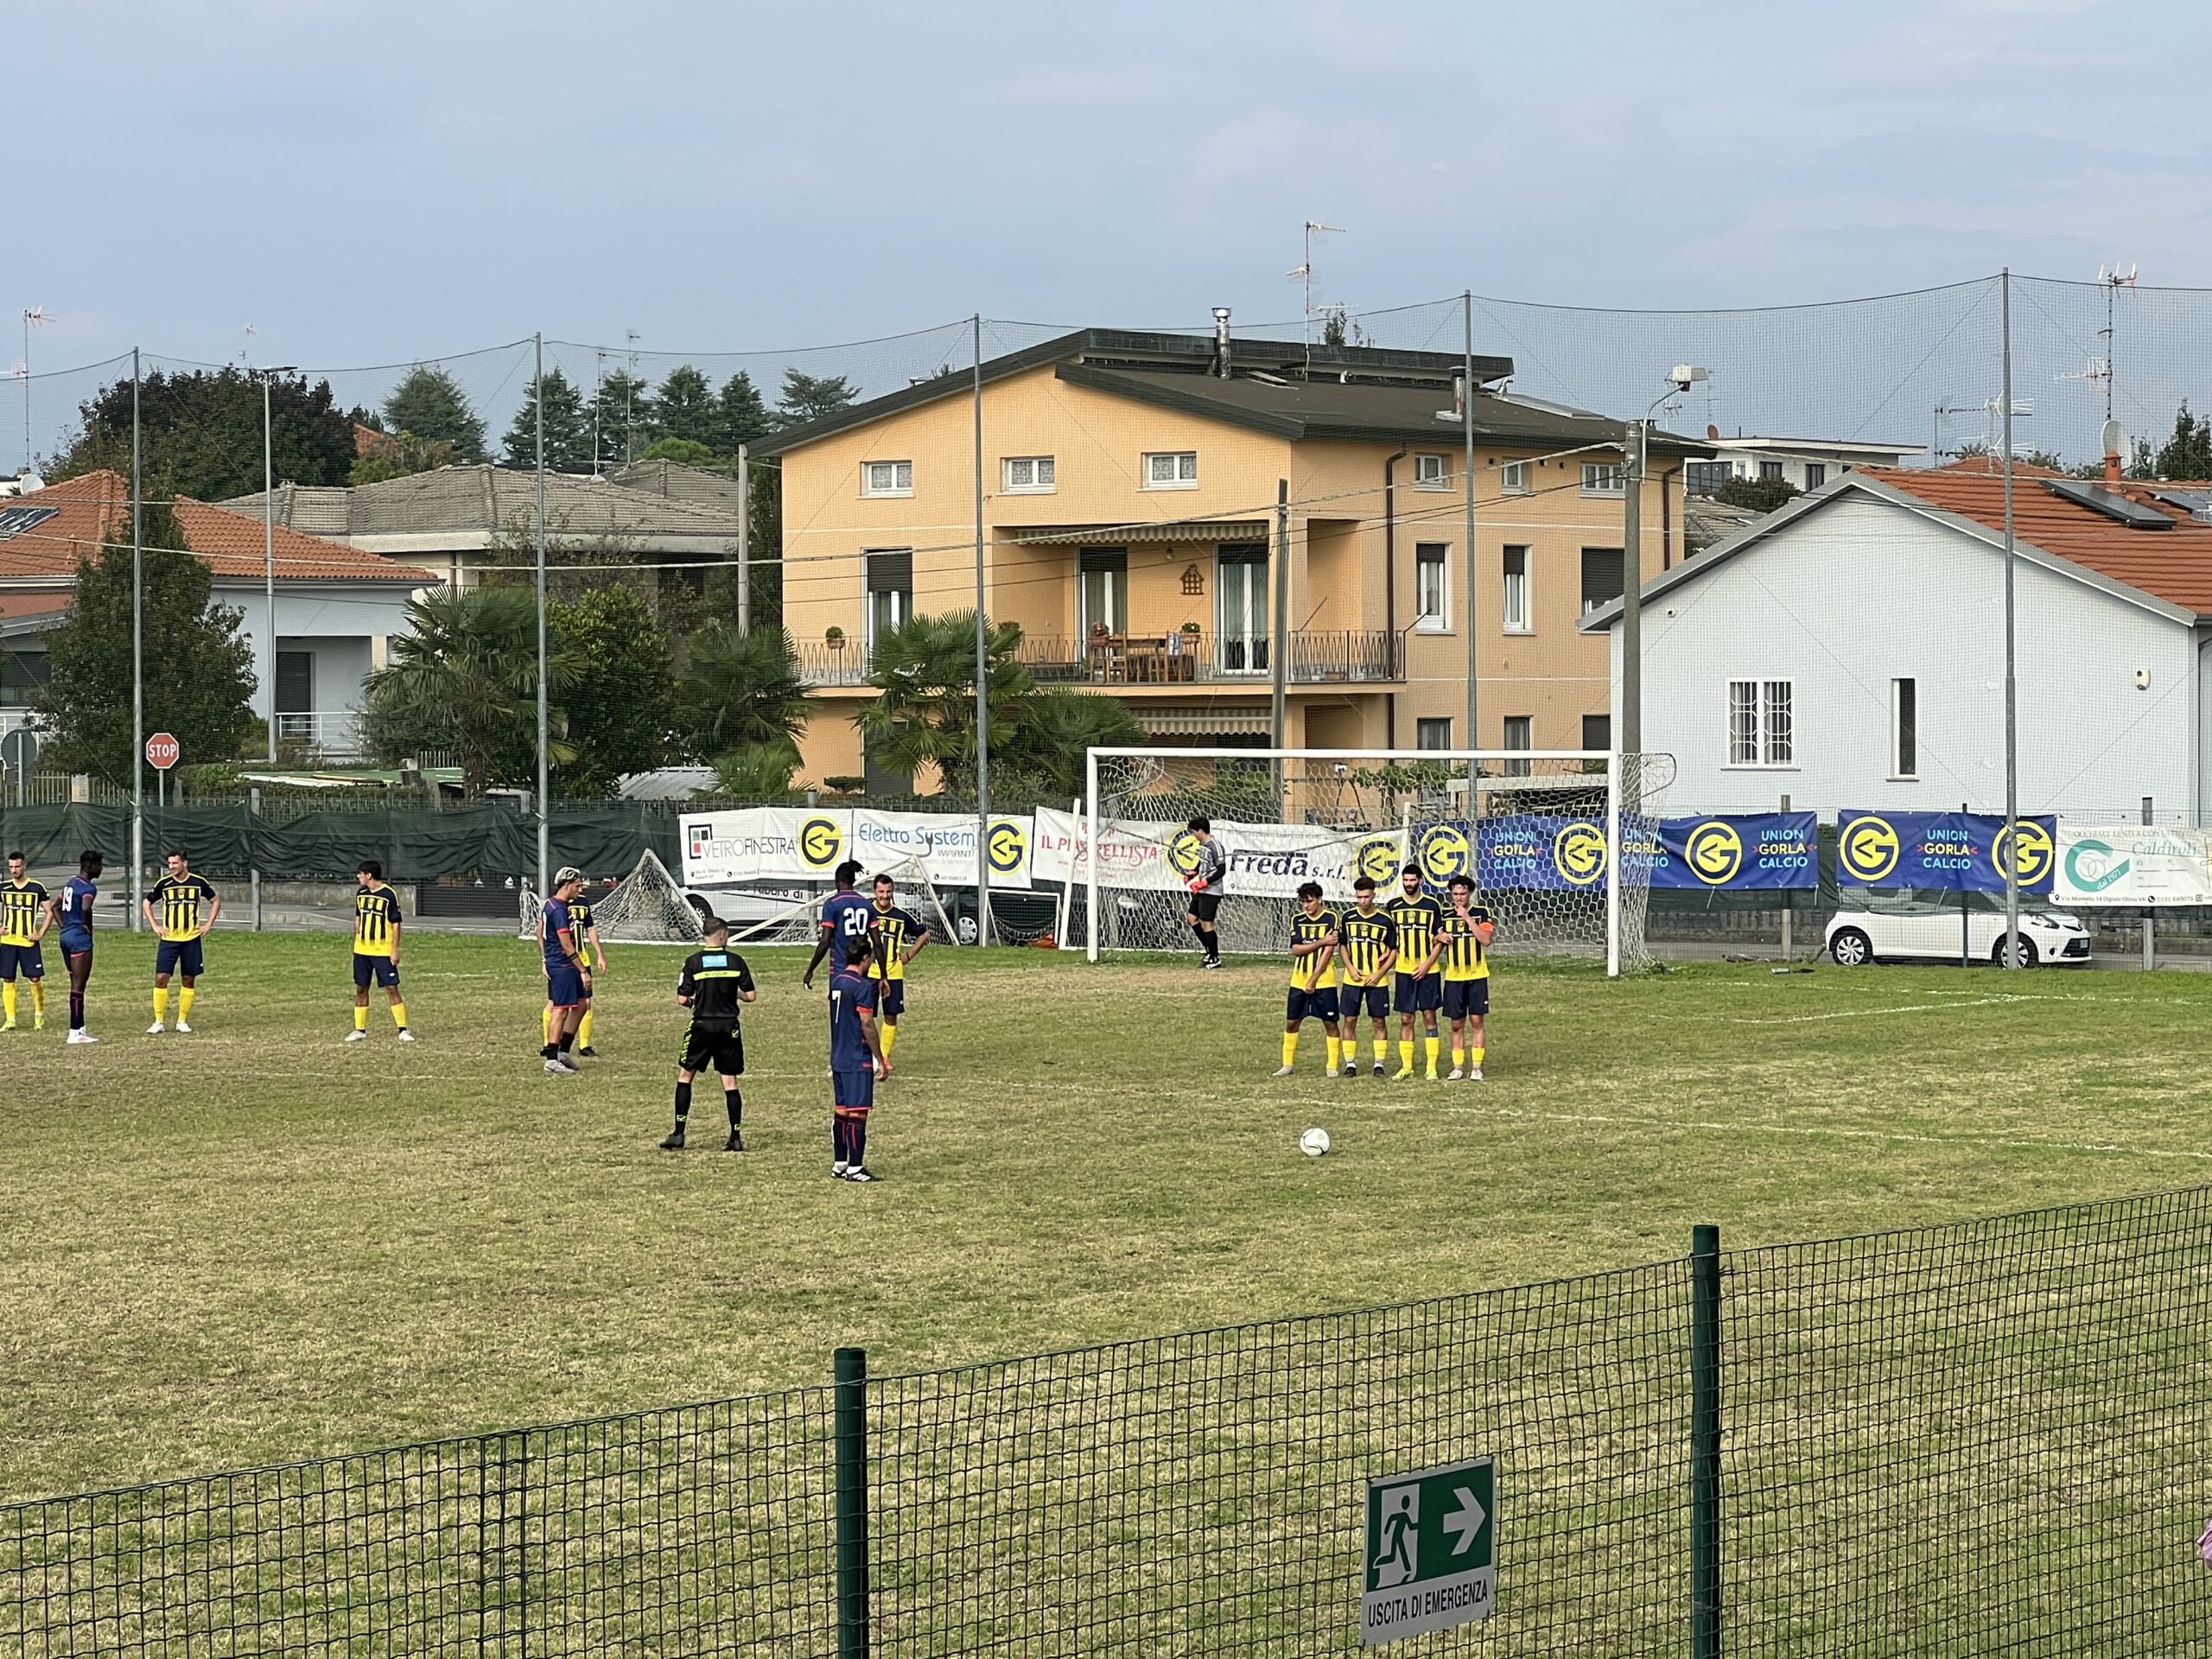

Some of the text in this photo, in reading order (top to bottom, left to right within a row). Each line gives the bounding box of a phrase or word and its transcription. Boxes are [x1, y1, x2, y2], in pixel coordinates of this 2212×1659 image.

[149, 744, 177, 758] STOP
[859, 823, 976, 847] Elettro System
[1495, 830, 1535, 843] UNION
[1761, 830, 1804, 842] UNION
[1926, 829, 1968, 842] UNION
[701, 836, 798, 859] VETROFINESTRA
[1041, 836, 1053, 849] IL
[1621, 842, 1668, 855] GORLA
[1758, 842, 1807, 855] GORLA
[1923, 842, 1970, 855] GORLA
[938, 849, 975, 858] IMPIANTI
[1494, 844, 1535, 856] GORLA
[1493, 857, 1537, 869] CALCIO
[1620, 855, 1669, 868] CALCIO
[1758, 856, 1808, 869] CALCIO
[1923, 857, 1972, 870] CALCIO
[1311, 864, 1346, 880] s.r.l.
[61, 886, 73, 912] 19
[842, 907, 868, 936] 20
[831, 990, 842, 1024] 7
[1368, 1579, 1488, 1628] USCITA DI EMERGENZA
